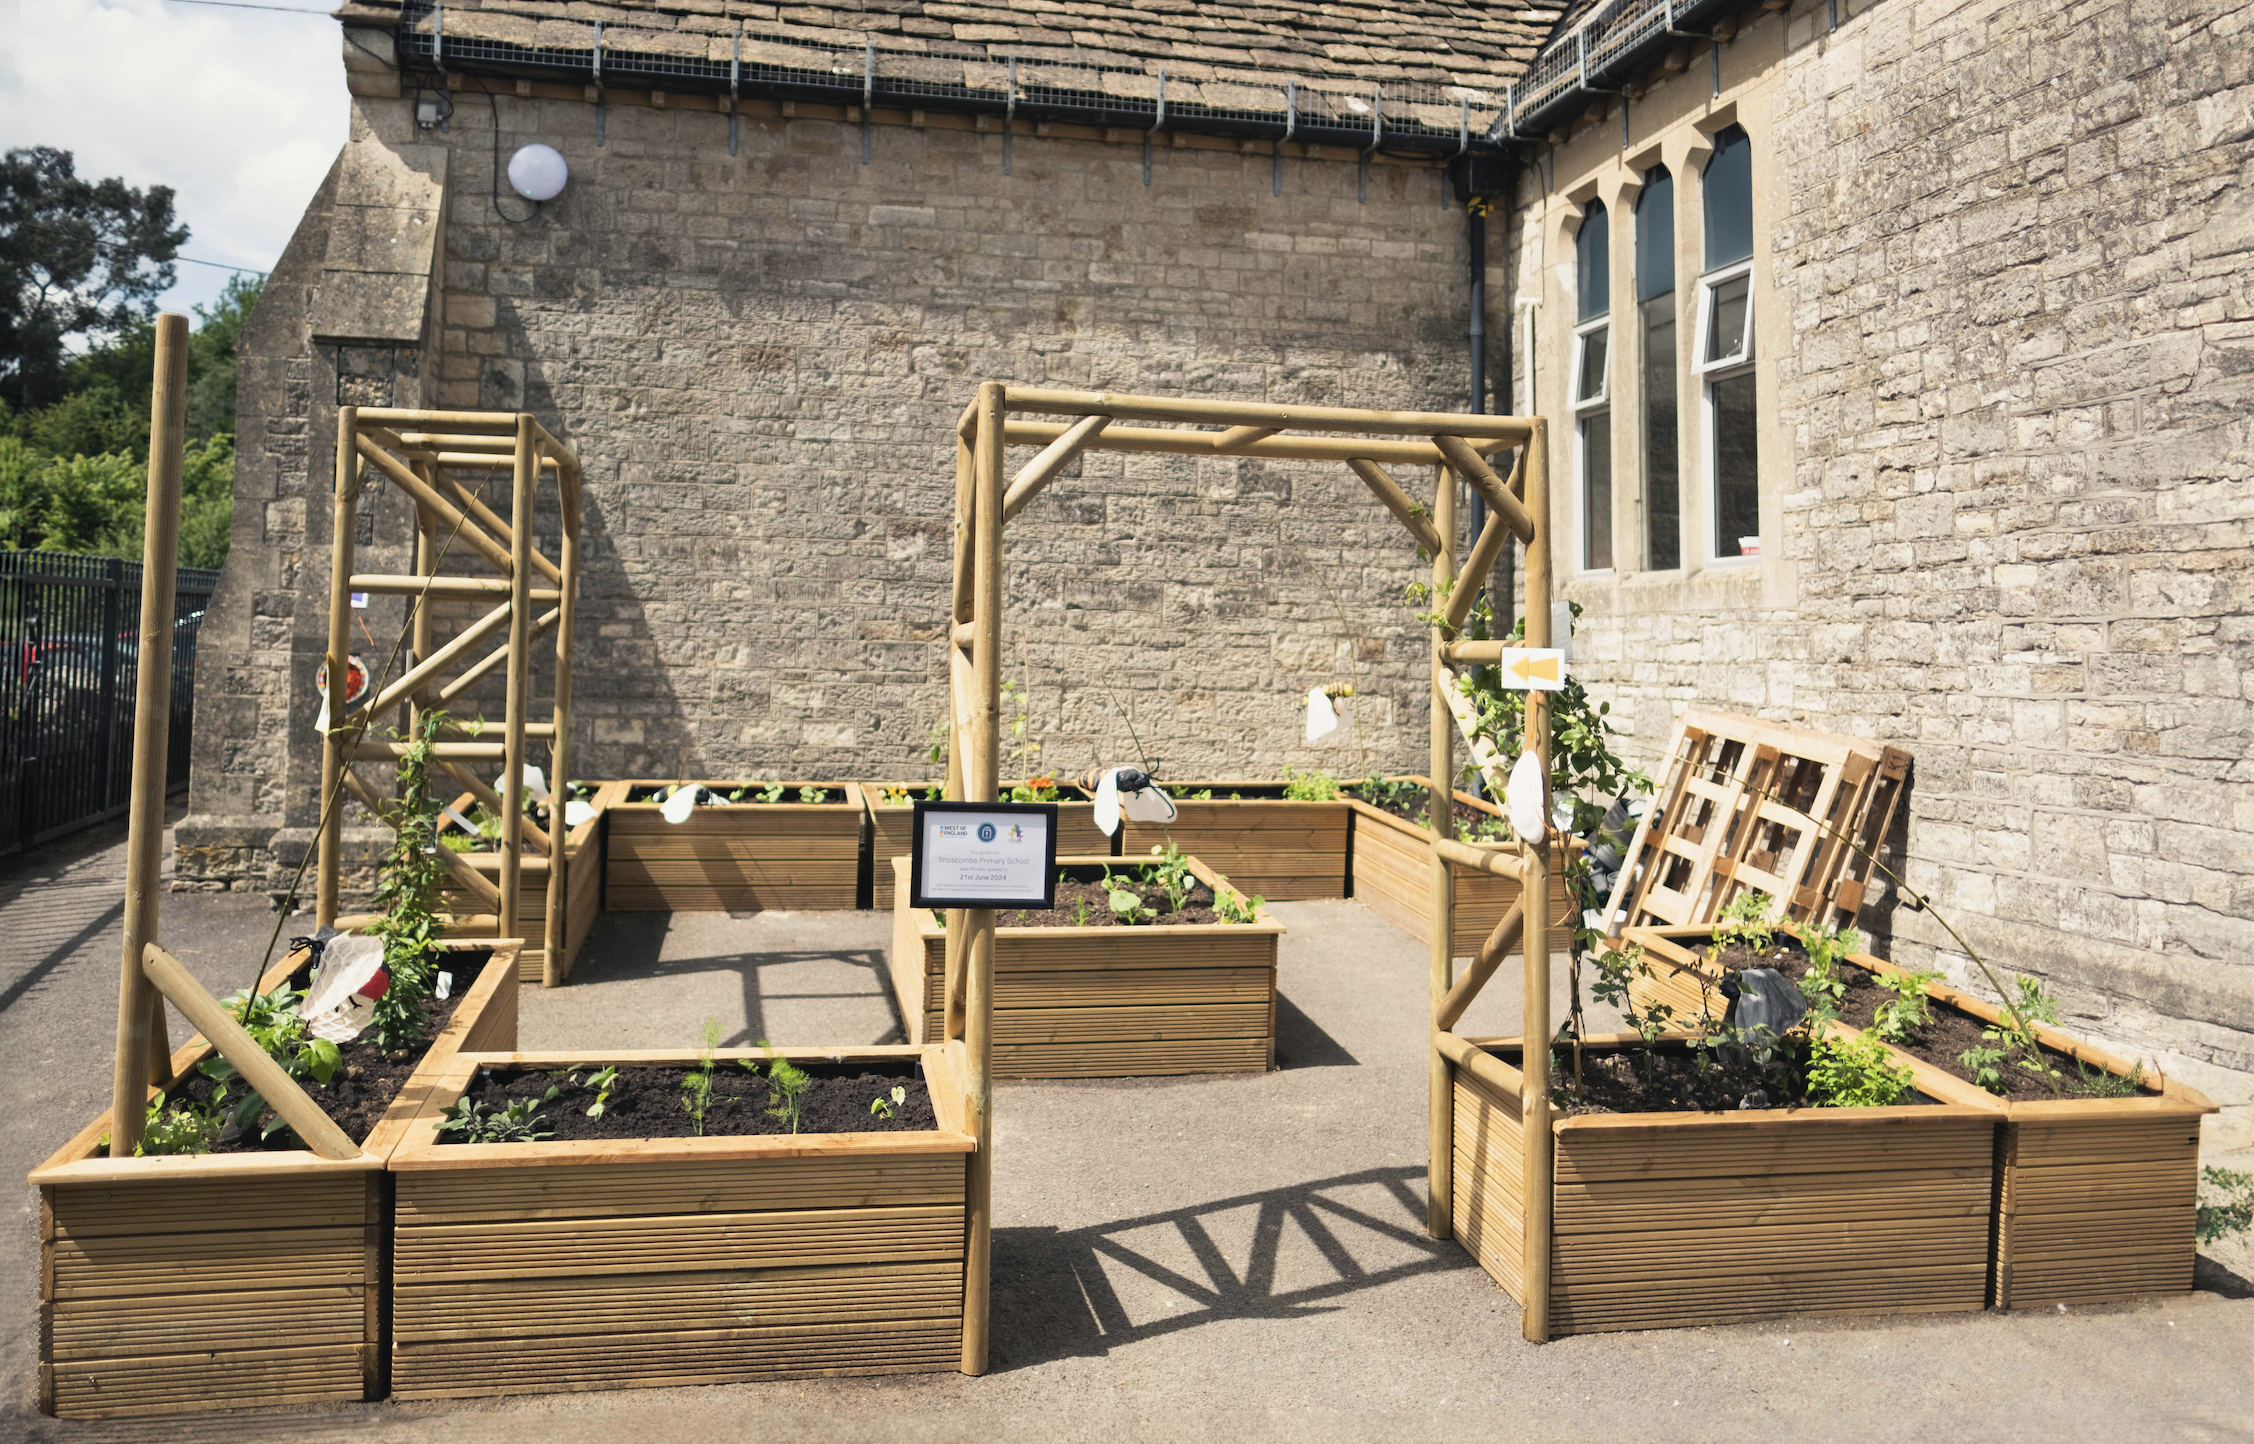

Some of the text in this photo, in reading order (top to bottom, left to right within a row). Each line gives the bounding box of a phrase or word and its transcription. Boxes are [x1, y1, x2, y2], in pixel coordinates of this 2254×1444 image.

[938, 856, 1030, 866] Shoscombe Primary School
